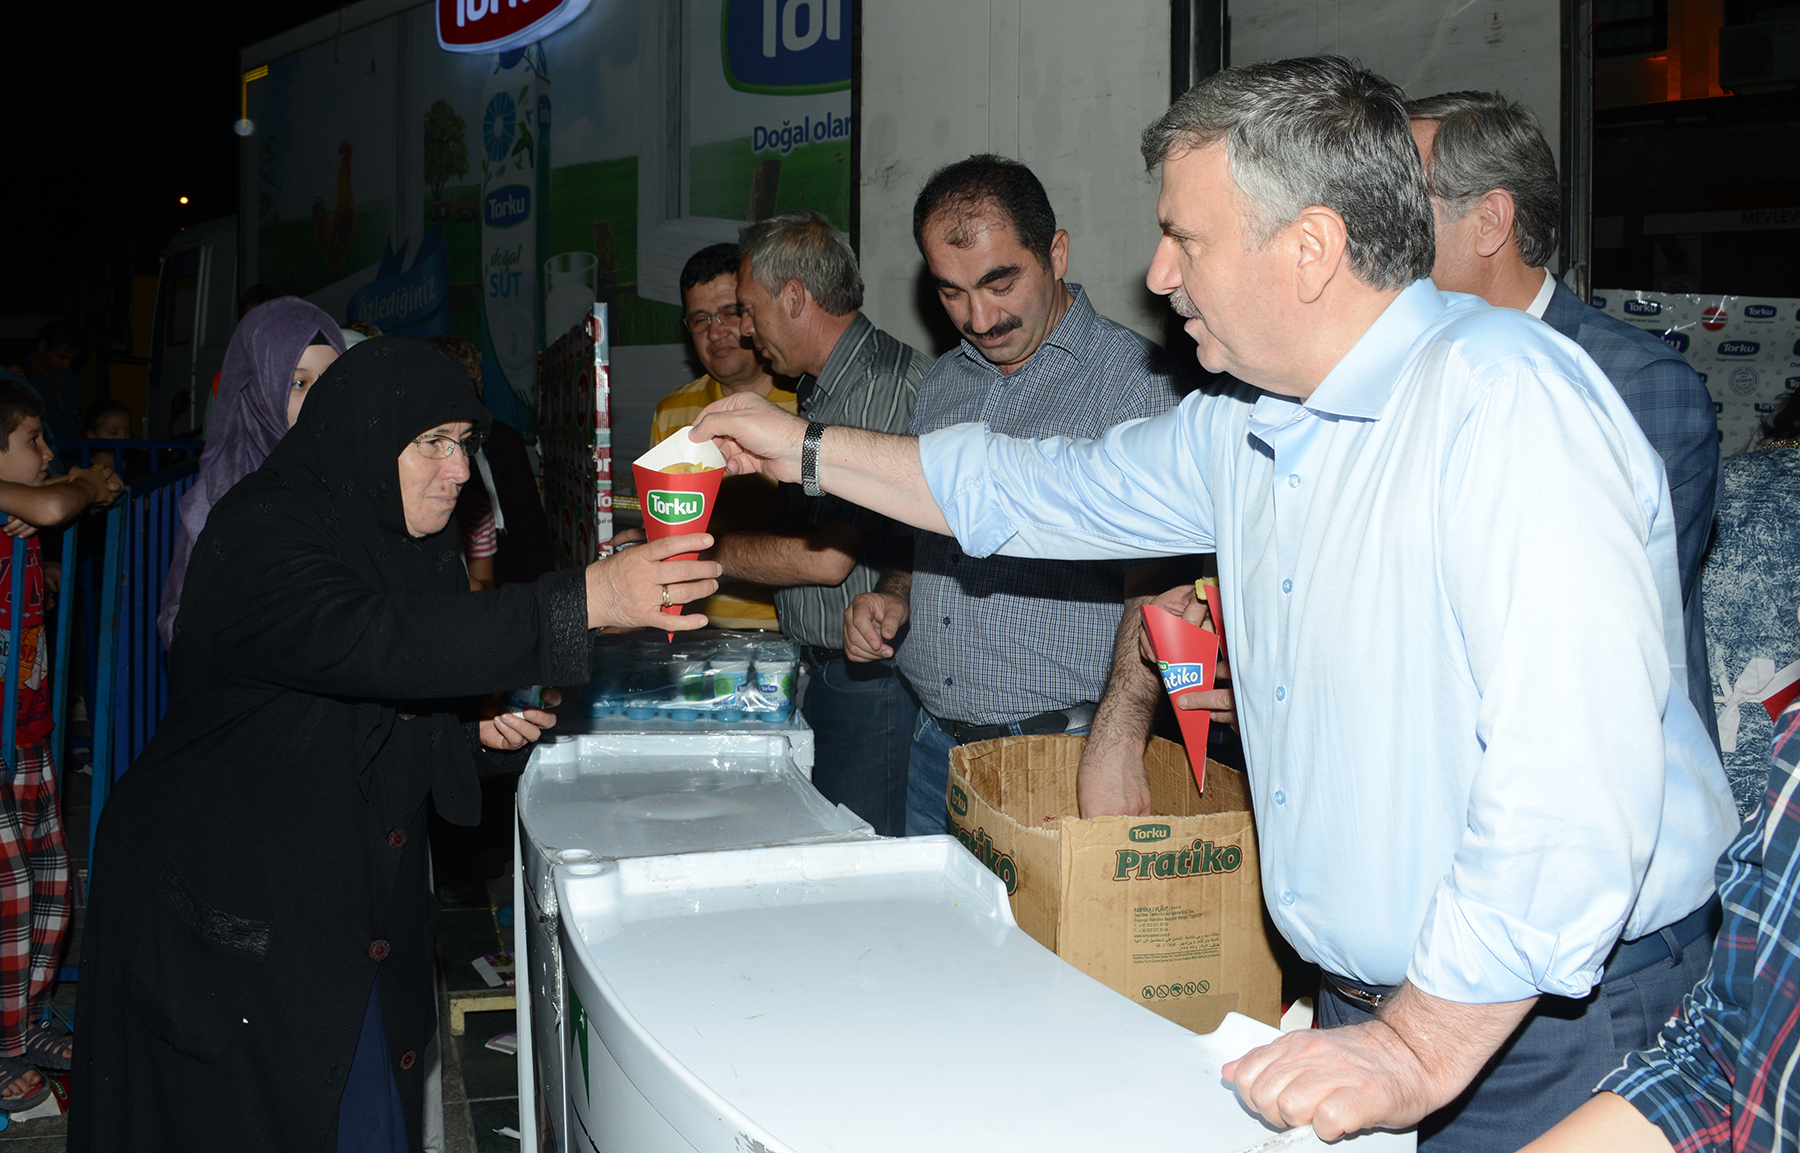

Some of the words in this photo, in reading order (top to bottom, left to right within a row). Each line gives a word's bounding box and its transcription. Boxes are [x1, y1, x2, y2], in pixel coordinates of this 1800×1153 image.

[754, 116, 809, 153] Doğal
[489, 194, 524, 219] Torku
[491, 244, 522, 273] doğal
[490, 268, 522, 298] SÜT
[1628, 302, 1657, 313] Torku
[1748, 307, 1774, 316] Torku
[1723, 343, 1755, 352] Torku
[651, 494, 697, 516] Torku
[1133, 827, 1167, 839] Torku
[1113, 839, 1243, 881] Pratiko
